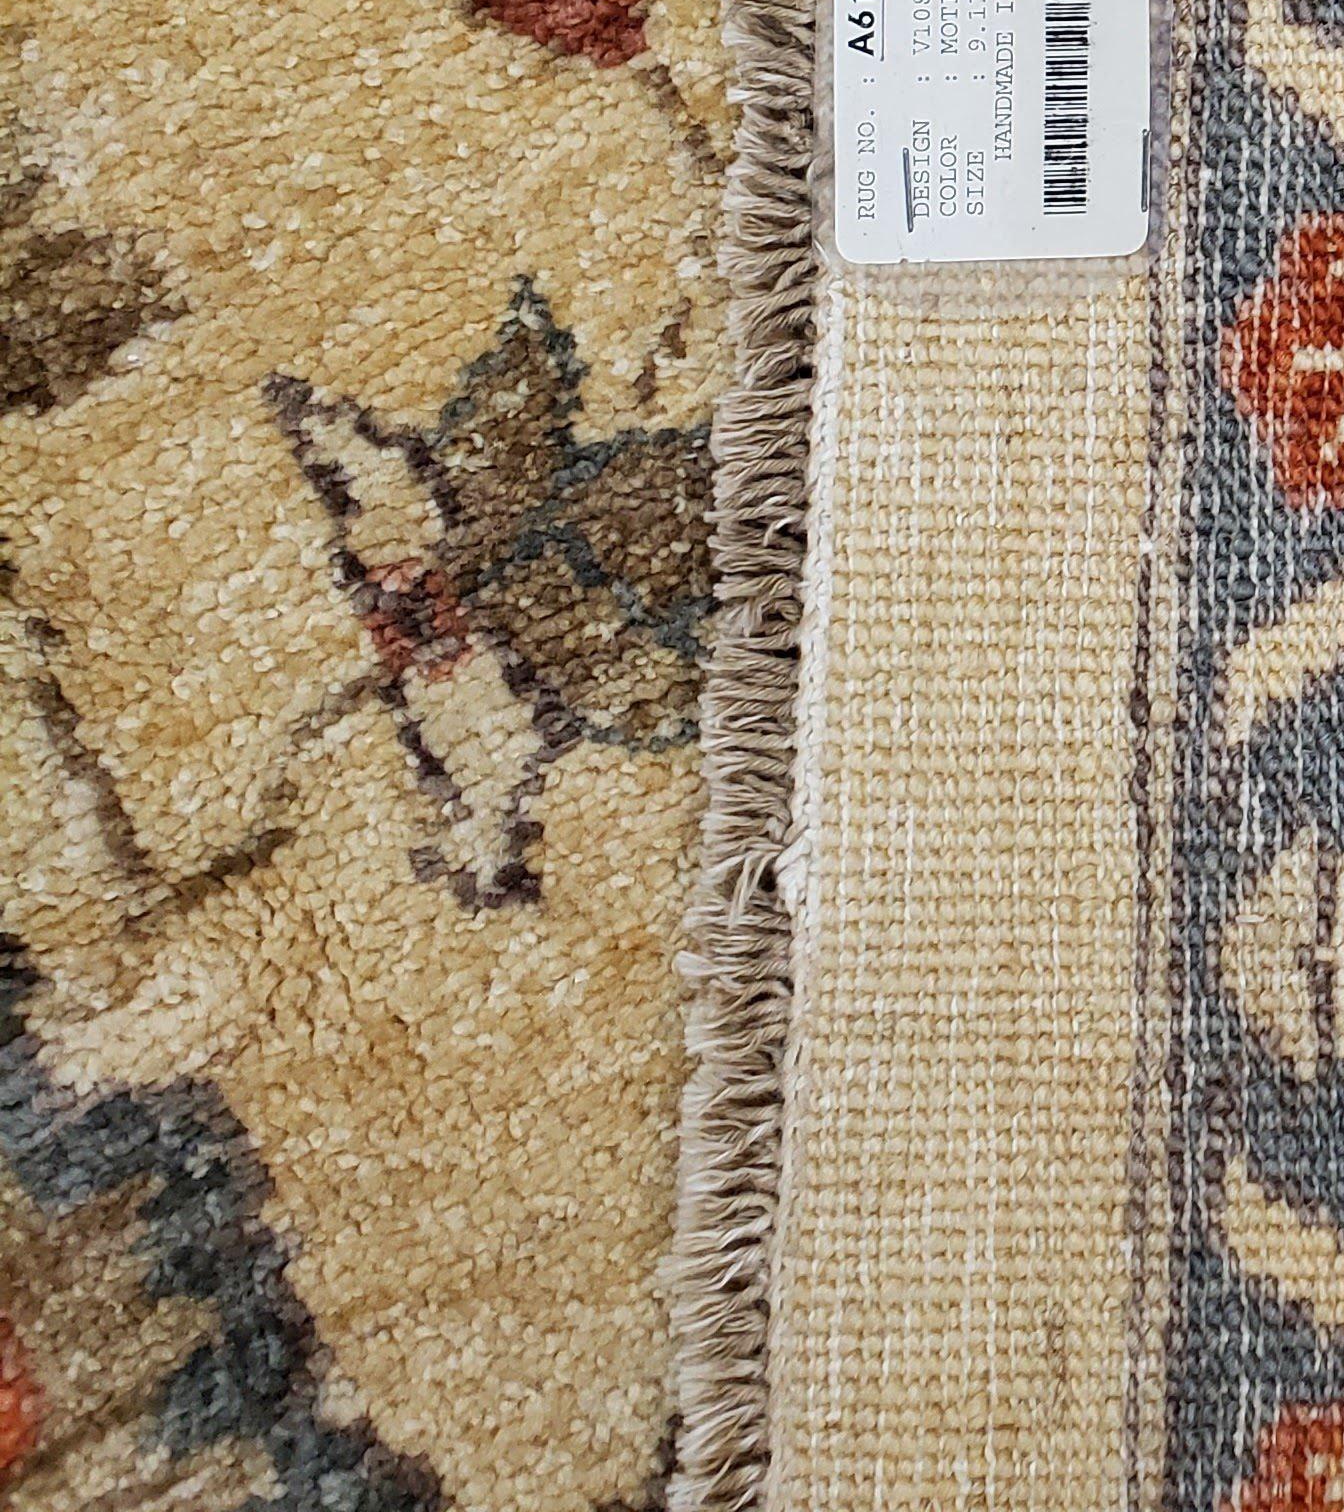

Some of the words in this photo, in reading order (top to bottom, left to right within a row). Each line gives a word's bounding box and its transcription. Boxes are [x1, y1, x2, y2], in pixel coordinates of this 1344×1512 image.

[857, 109, 876, 154] NO.
[993, 30, 1014, 160] HANDMADE
[857, 169, 875, 220] RUG
[912, 118, 930, 218] DESIGN
[939, 133, 958, 217] COLOR
[966, 149, 985, 215] SIZE
